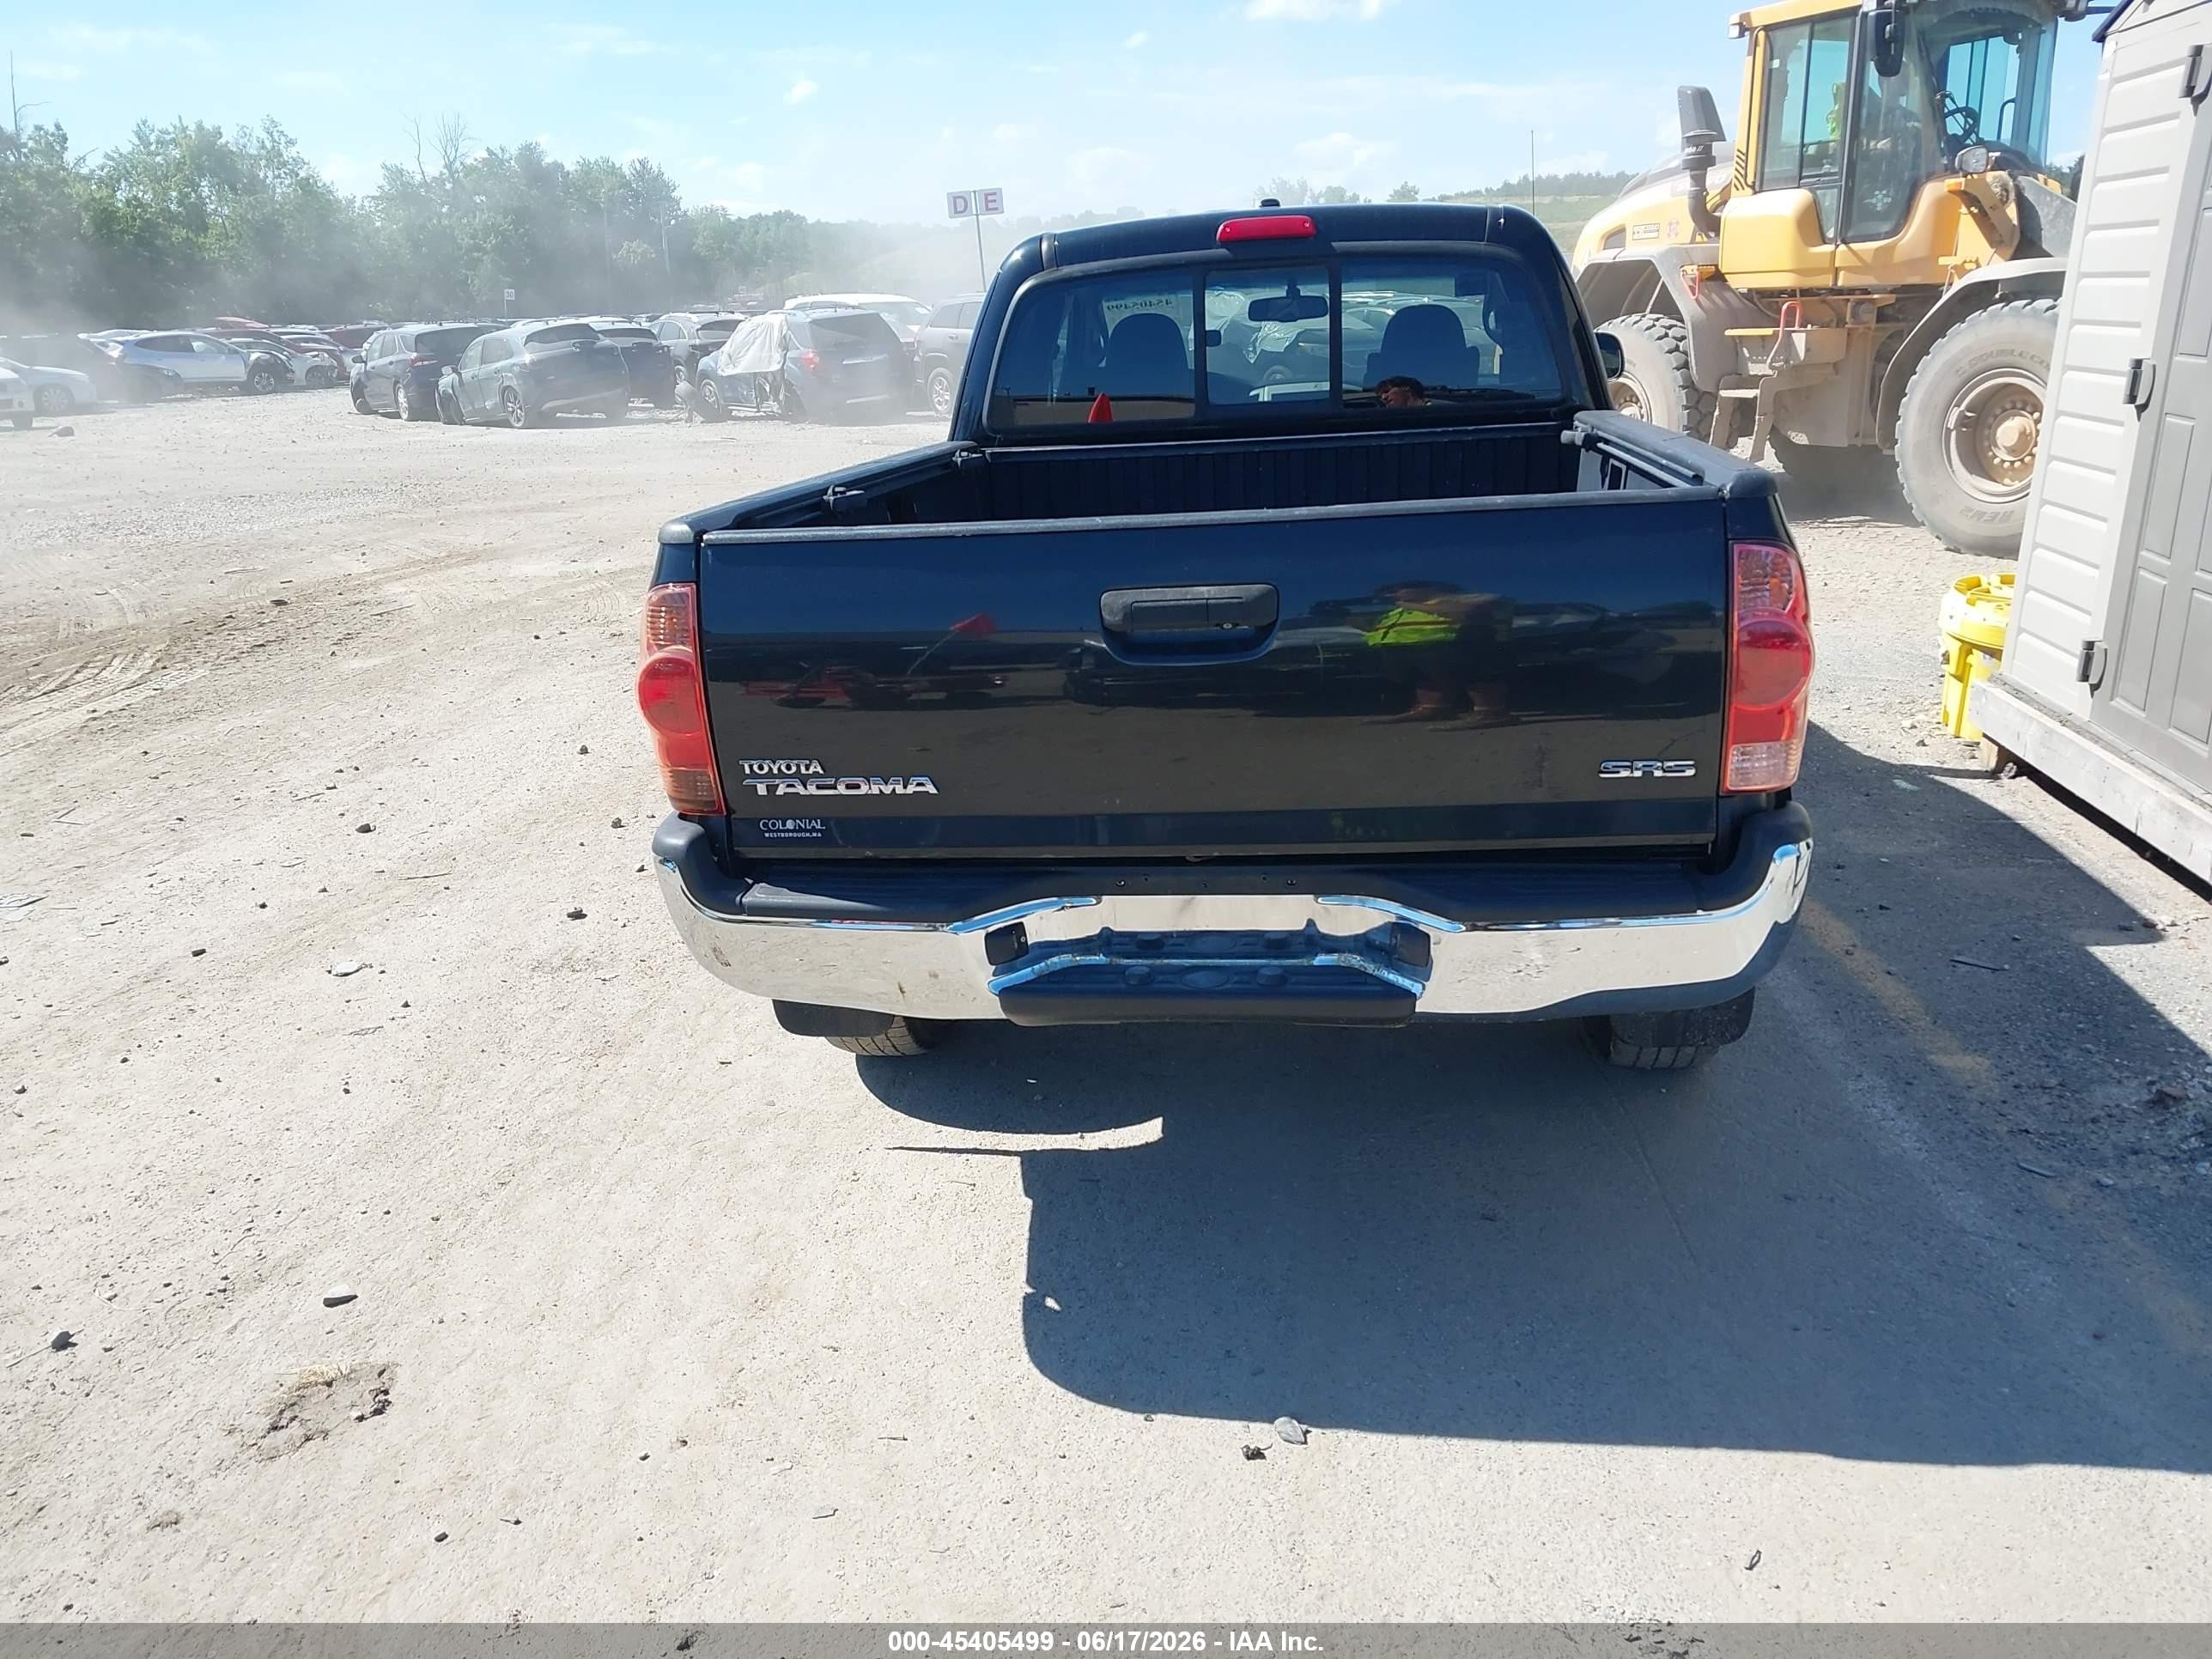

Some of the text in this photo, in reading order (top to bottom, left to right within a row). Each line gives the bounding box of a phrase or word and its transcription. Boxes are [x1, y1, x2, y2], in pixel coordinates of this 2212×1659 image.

[952, 195, 969, 214] D
[984, 191, 999, 211] E
[739, 760, 824, 775] TOYOTA
[1598, 760, 1697, 778] SR5
[742, 776, 940, 796] TACOMA
[759, 818, 826, 830] COLONIAL
